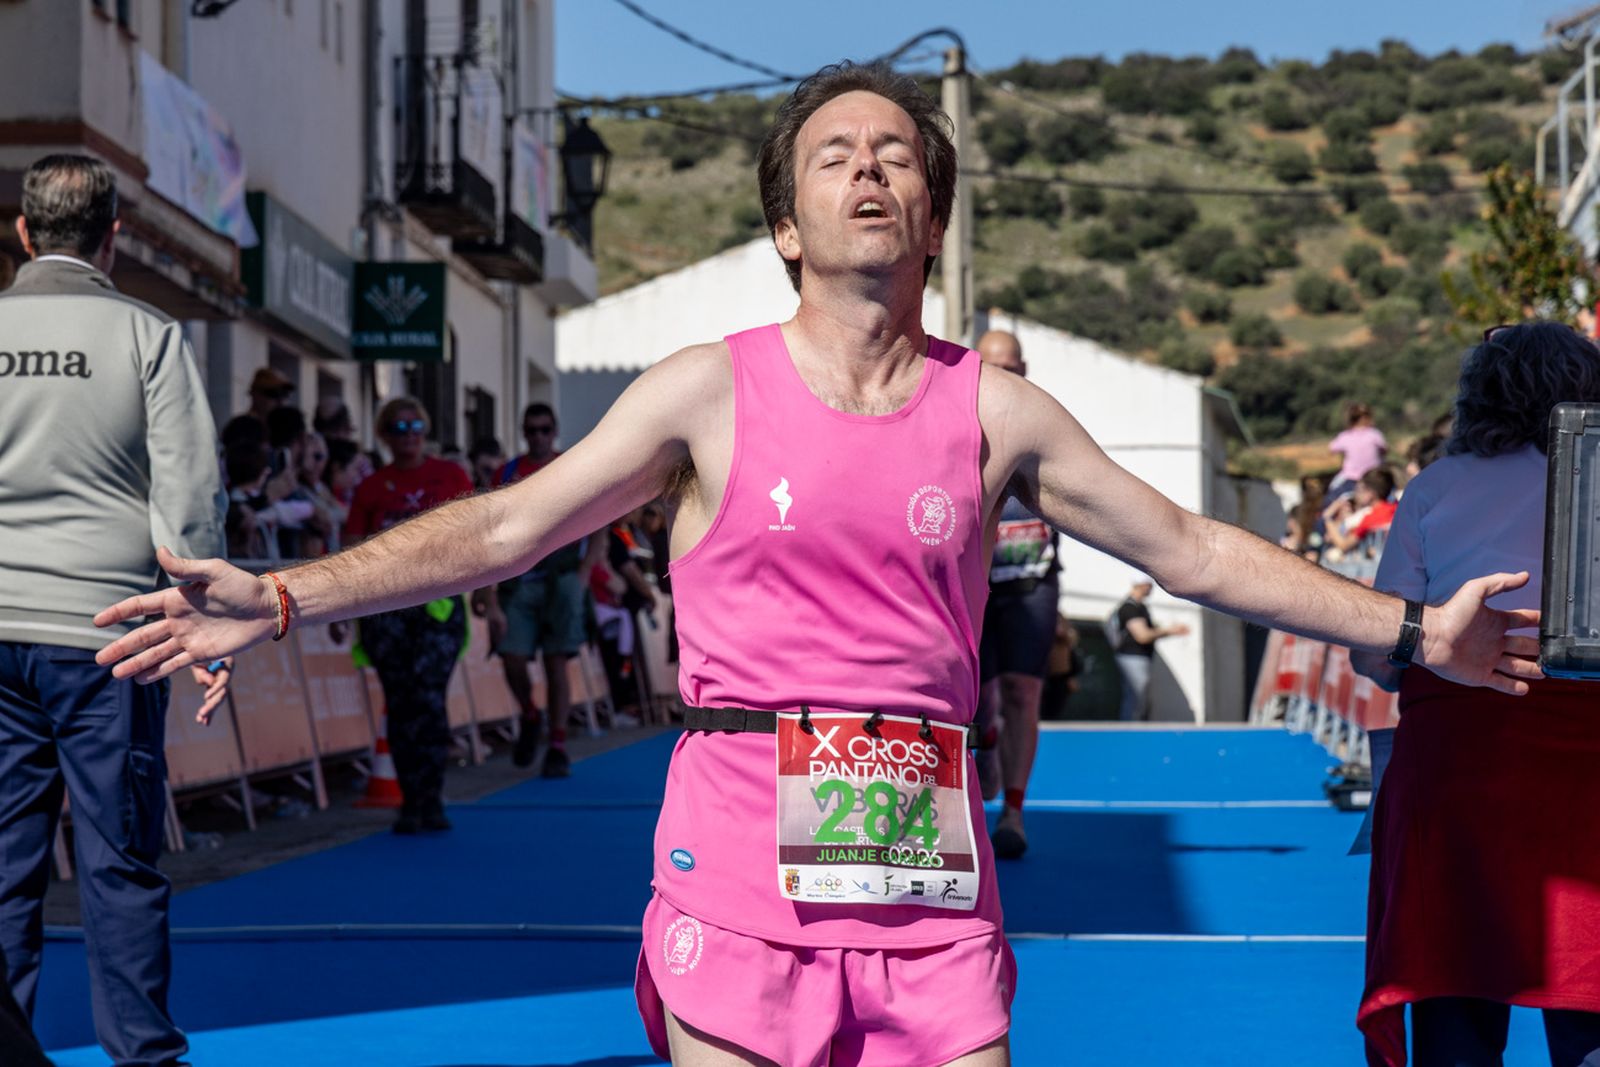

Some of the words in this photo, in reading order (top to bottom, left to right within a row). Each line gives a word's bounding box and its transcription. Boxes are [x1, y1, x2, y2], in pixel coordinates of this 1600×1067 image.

[809, 725, 842, 758] X
[847, 735, 939, 769] CROSS
[809, 760, 921, 788] PANTANO
[814, 779, 940, 852] 284
[816, 848, 876, 862] JUANJE
